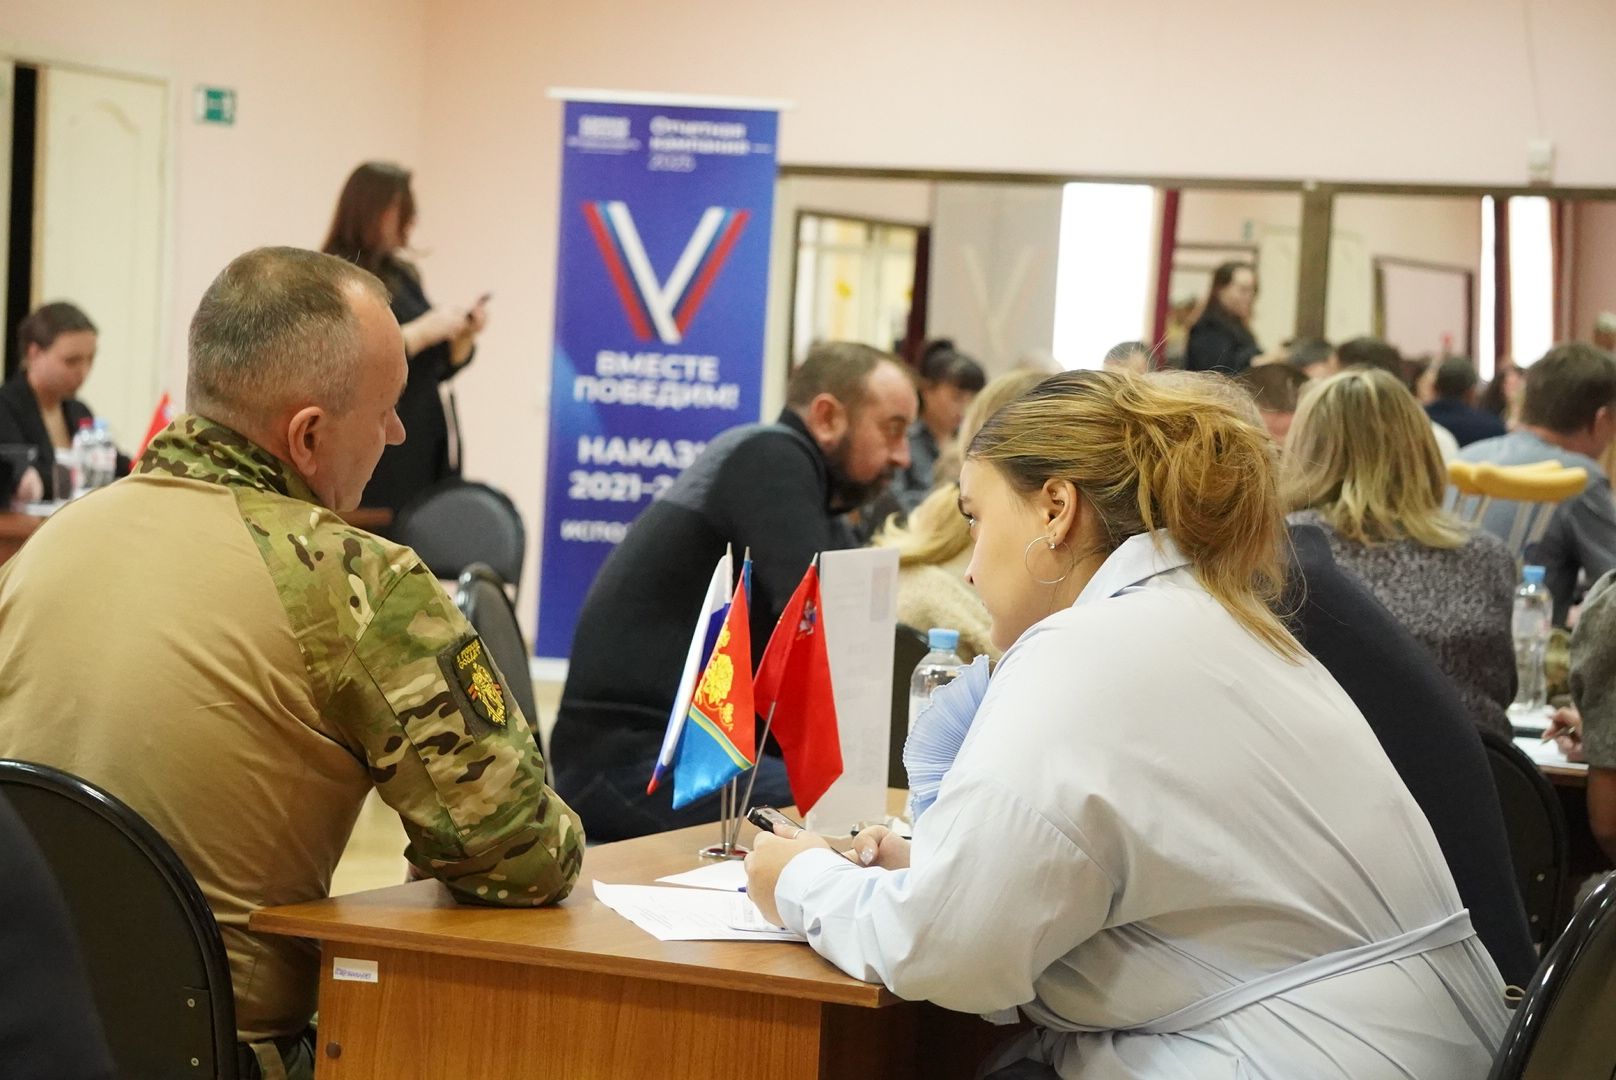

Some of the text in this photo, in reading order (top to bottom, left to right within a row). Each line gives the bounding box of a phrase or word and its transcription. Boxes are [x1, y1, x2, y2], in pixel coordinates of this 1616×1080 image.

[596, 351, 720, 381] ВМЕСТЕ
[574, 375, 741, 410] ПОБЕДИМ!
[568, 470, 673, 502] 2021-2
[560, 519, 632, 543] испо
